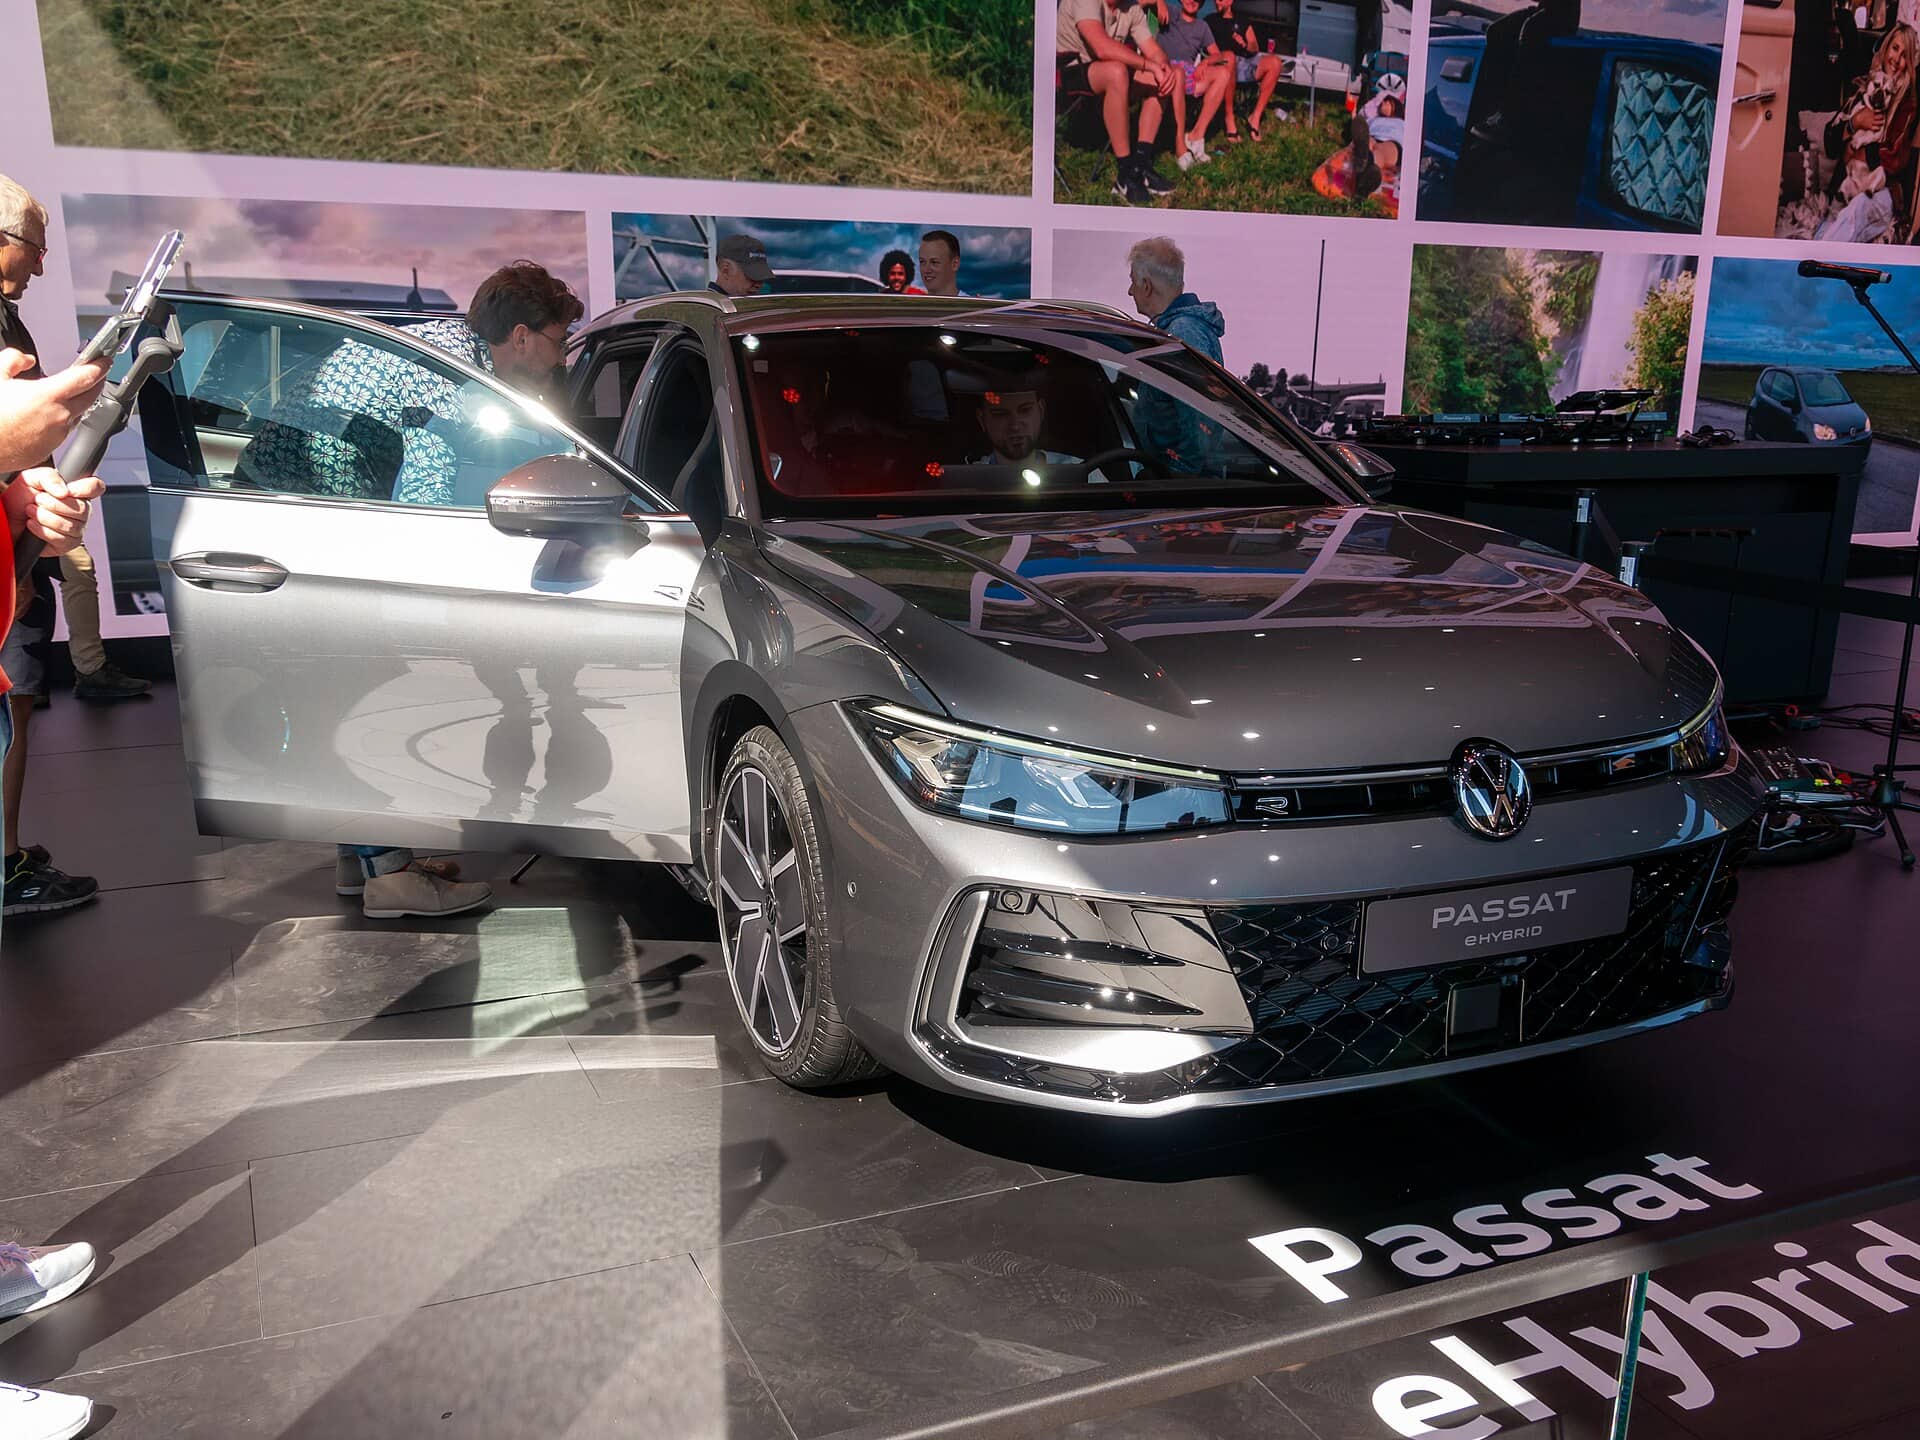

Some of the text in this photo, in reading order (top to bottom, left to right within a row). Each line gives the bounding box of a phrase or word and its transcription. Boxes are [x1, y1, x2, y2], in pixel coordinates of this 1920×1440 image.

[1432, 888, 1577, 929] PASSAT
[1464, 925, 1543, 946] eHYBRID
[1248, 1153, 1762, 1304] Passat
